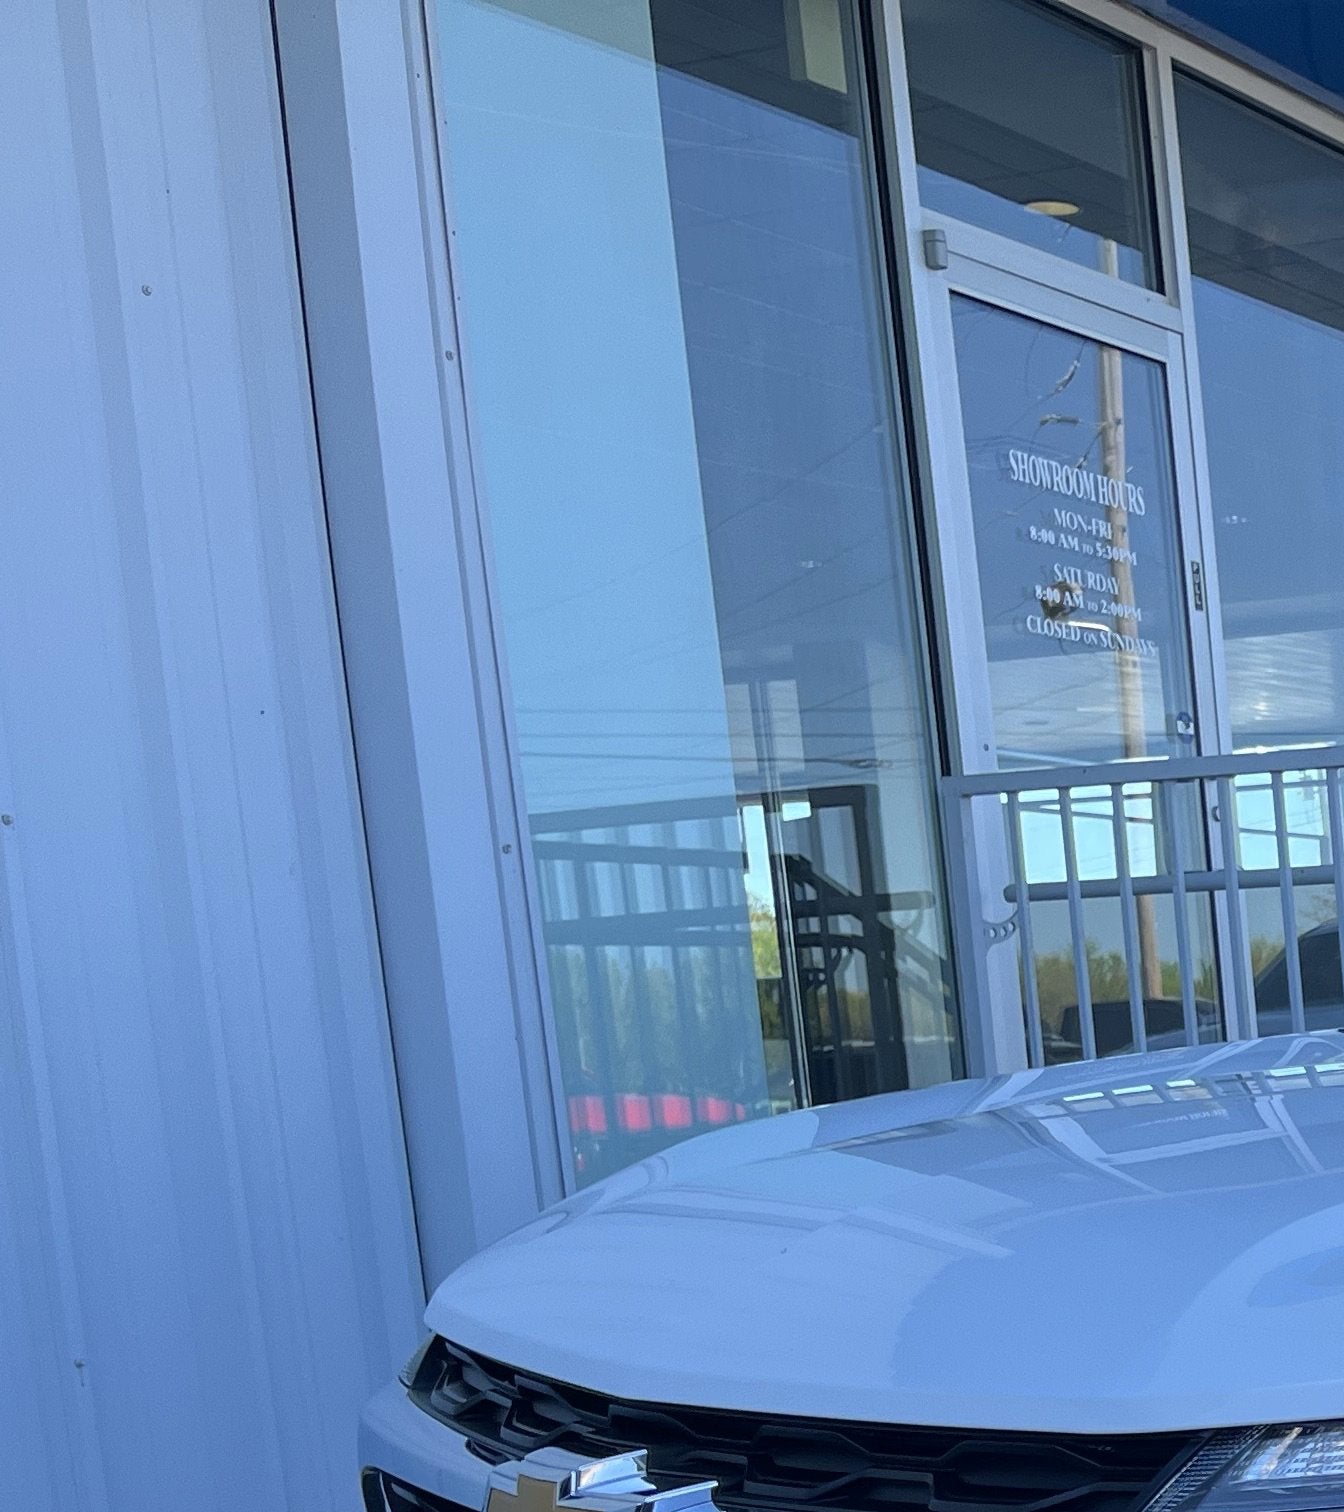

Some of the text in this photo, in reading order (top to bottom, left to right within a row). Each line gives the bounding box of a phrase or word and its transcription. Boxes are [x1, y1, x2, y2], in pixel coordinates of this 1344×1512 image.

[1008, 449, 1146, 517] SHOWROOM HOURS
[1053, 507, 1113, 541] MON-FRI
[1029, 525, 1056, 546] 8:00
[1057, 532, 1079, 552] AM
[1095, 542, 1138, 567] 5:30PM
[1034, 584, 1061, 605] 8:00
[1062, 592, 1085, 609] AM
[1053, 562, 1120, 596] SATURDAY
[1191, 561, 1204, 610] PULL
[1026, 614, 1081, 642] CLOSED
[1099, 630, 1157, 657] SUNDAYS
